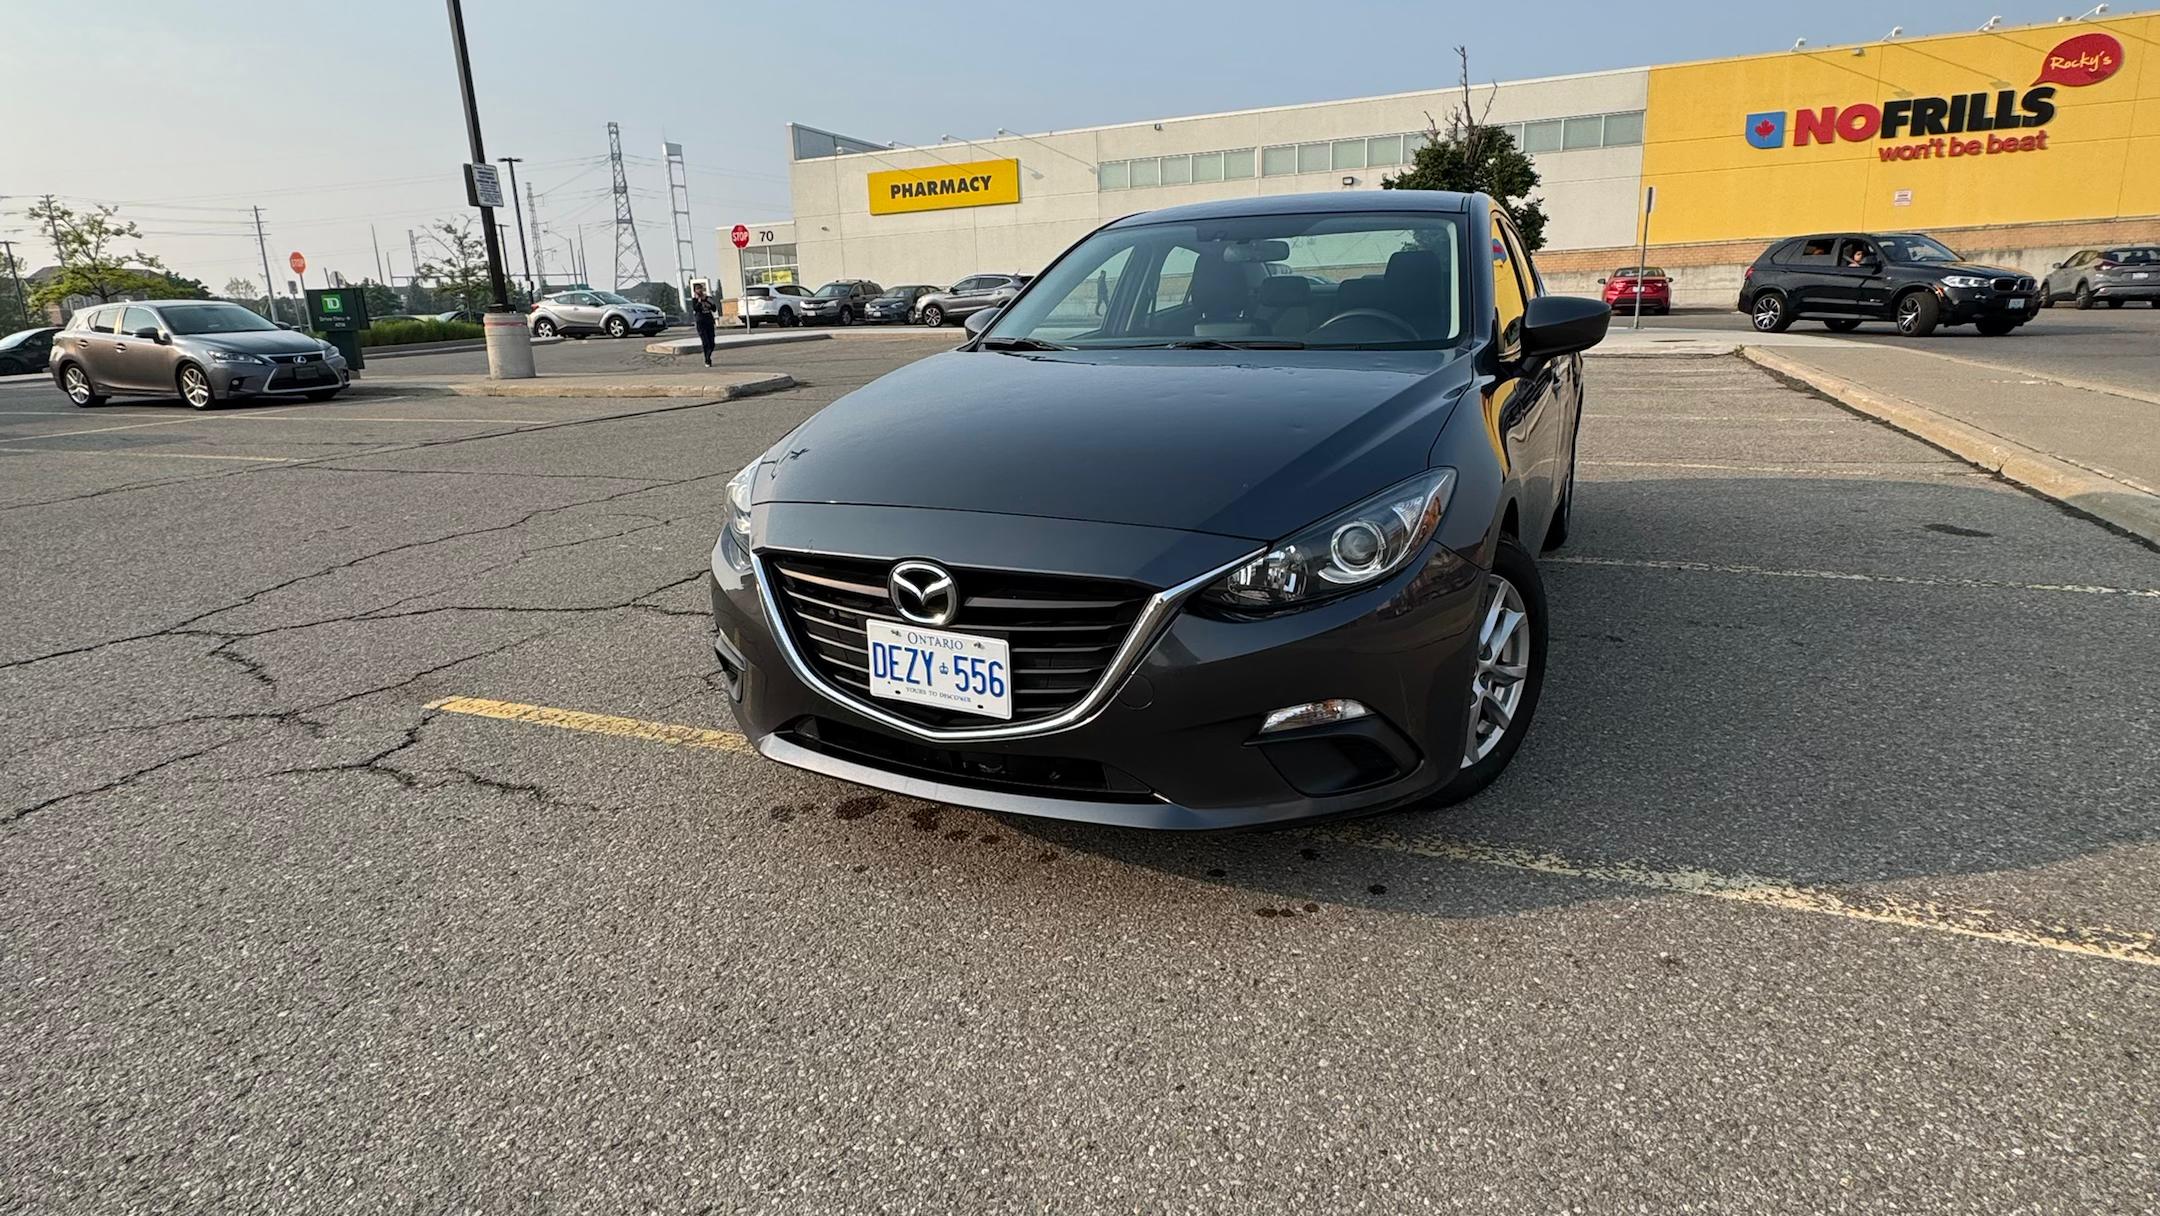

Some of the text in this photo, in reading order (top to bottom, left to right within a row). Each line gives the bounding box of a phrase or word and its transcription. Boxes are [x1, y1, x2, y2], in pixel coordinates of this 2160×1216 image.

[2050, 50, 2112, 73] Rocky's
[1879, 130, 2048, 162] won't be beat
[890, 175, 992, 199] PHARMACY
[732, 231, 748, 242] STOP
[759, 230, 774, 242] 70
[323, 297, 340, 309] TD
[907, 631, 963, 650] ONTARIO
[872, 642, 1005, 698] DEZY 556
